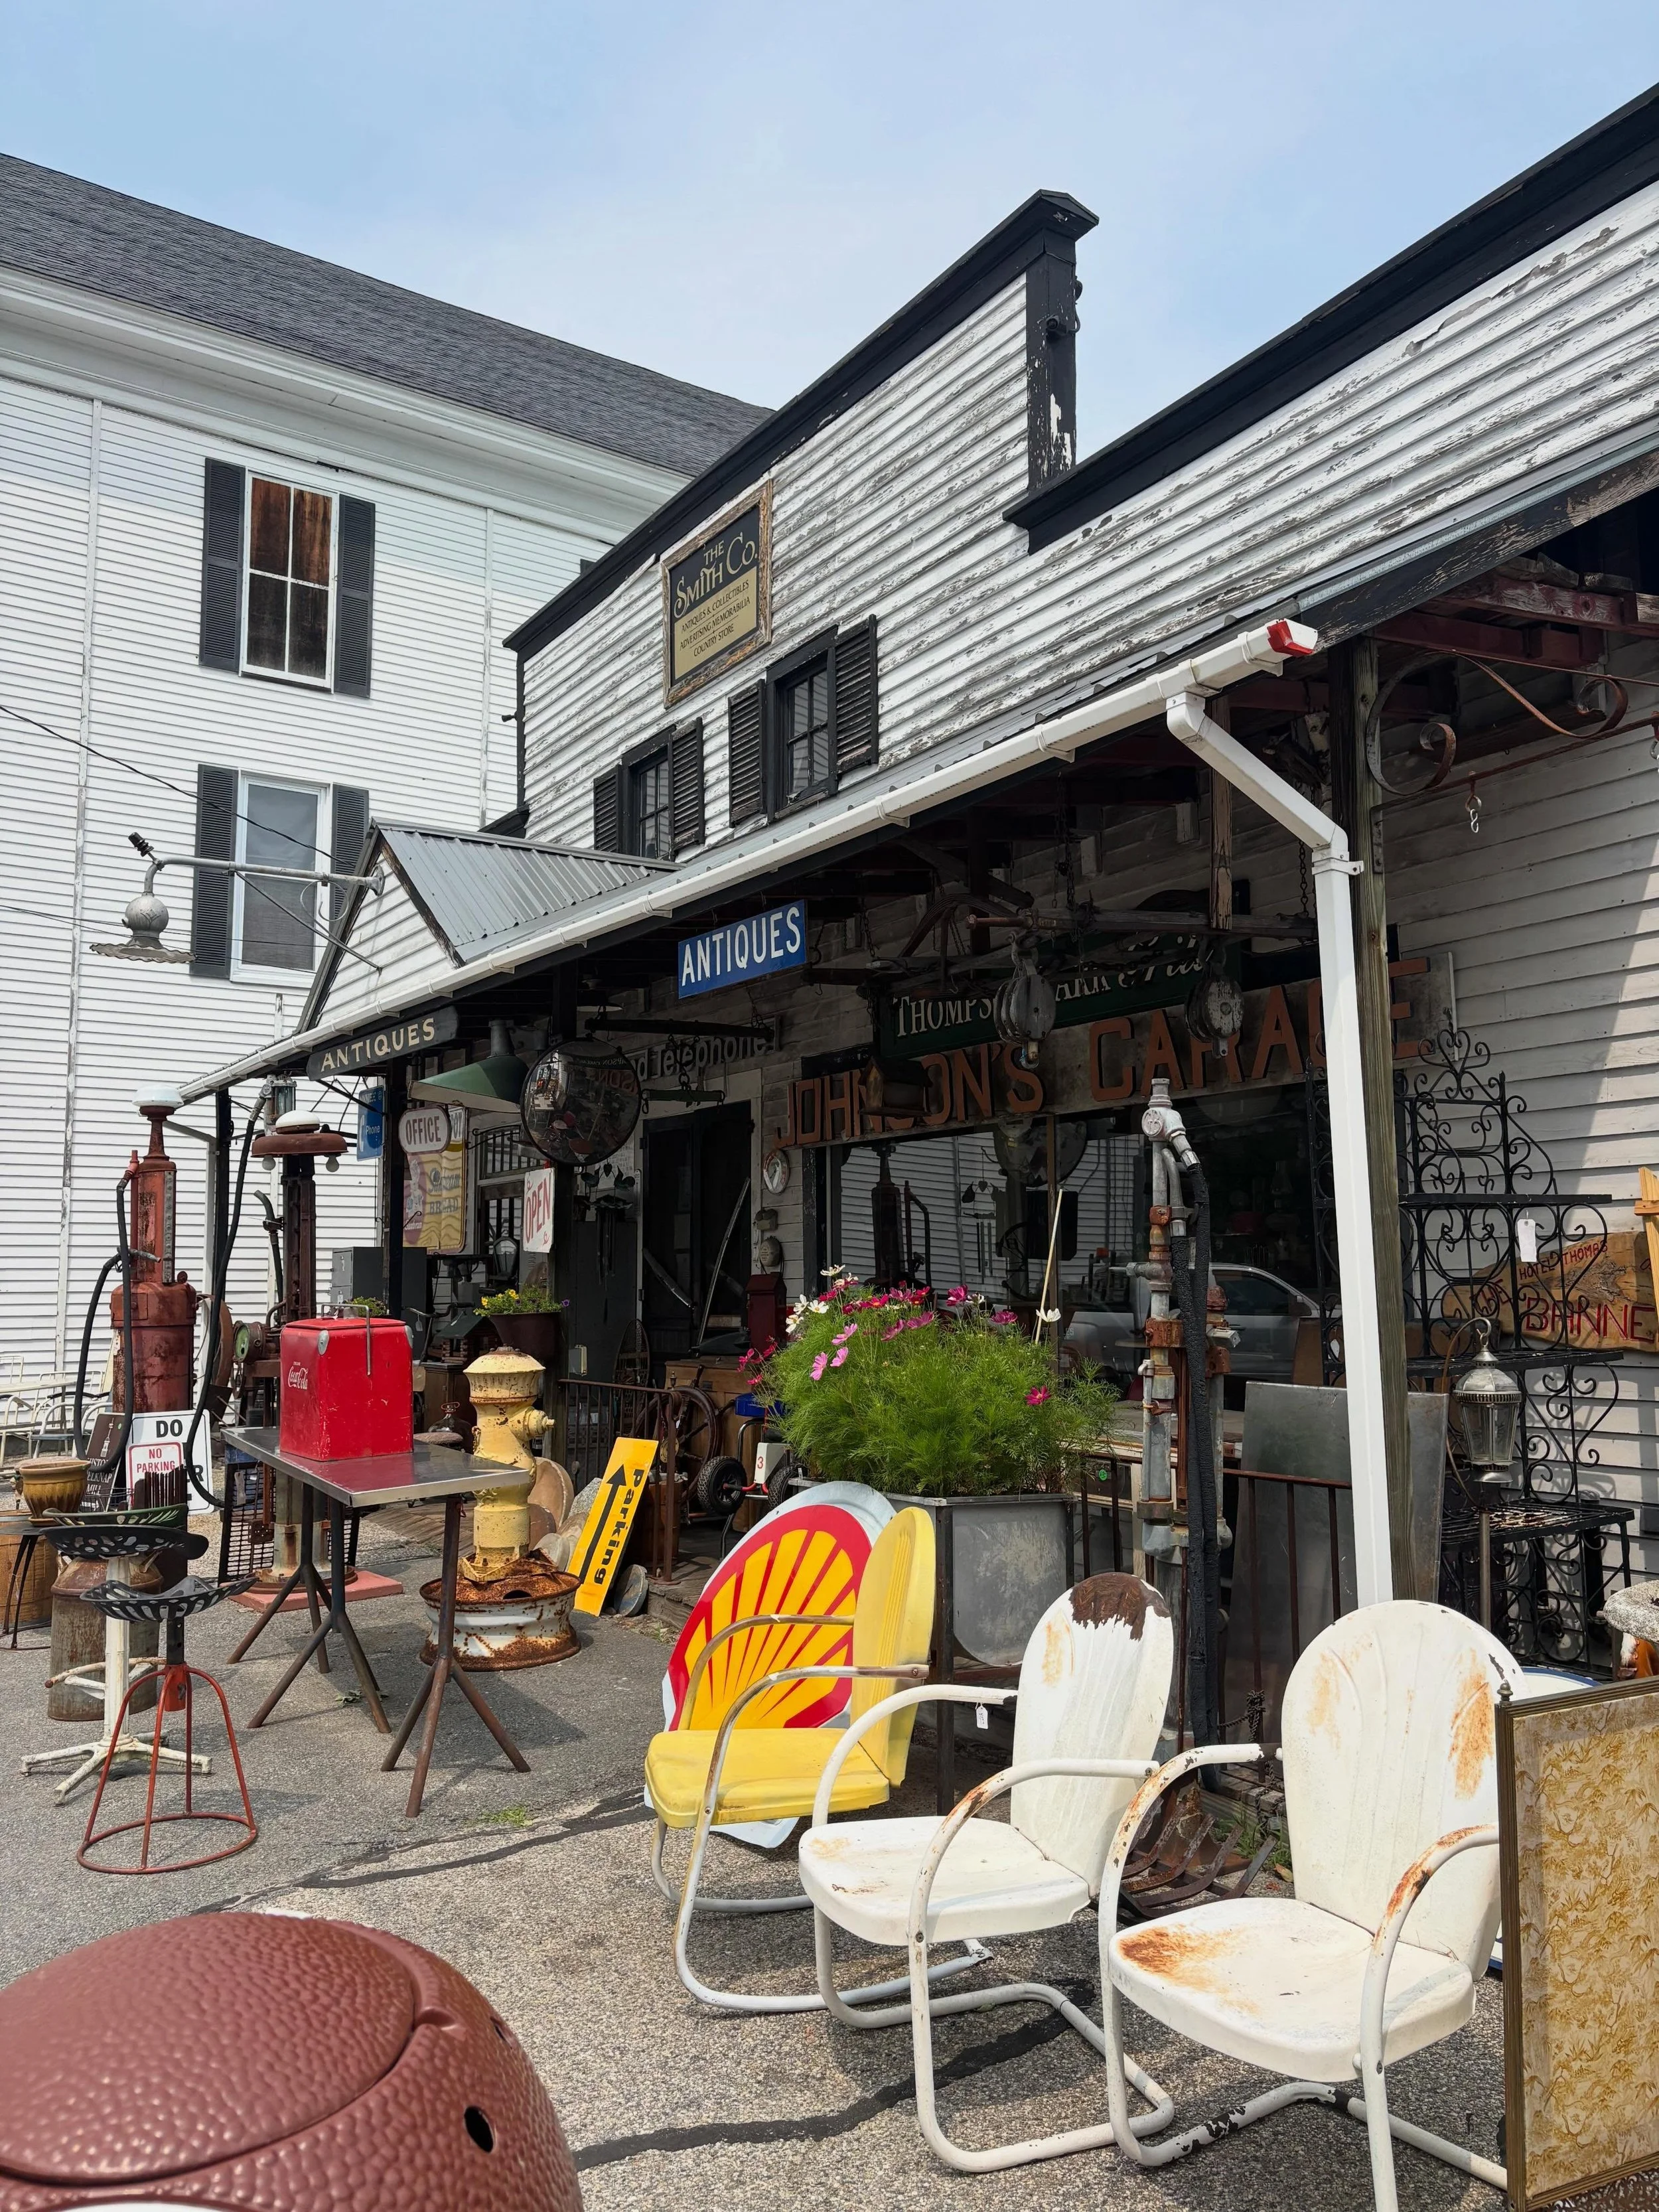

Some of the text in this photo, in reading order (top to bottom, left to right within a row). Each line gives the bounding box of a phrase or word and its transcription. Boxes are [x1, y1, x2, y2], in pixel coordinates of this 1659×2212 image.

[704, 540, 724, 565] THE
[681, 608, 706, 633] ANTIQUES
[712, 579, 749, 611] COLLECTIBLES
[680, 597, 751, 652] ADVERTISING MEMORABILIA
[693, 623, 734, 657] COUNTRY STORE
[682, 906, 801, 987] ANTIQUES
[893, 993, 995, 1039] THOMPS
[321, 1017, 435, 1072] ANTIQUES
[366, 1125, 380, 1136] Phone
[405, 1116, 442, 1145] OFFICE
[525, 1172, 551, 1244] OPEN
[155, 1419, 183, 1438] DO
[137, 1460, 176, 1473] PARKING
[149, 1448, 163, 1459] NO
[757, 1456, 764, 1469] 3
[593, 1468, 645, 1585] Parking
